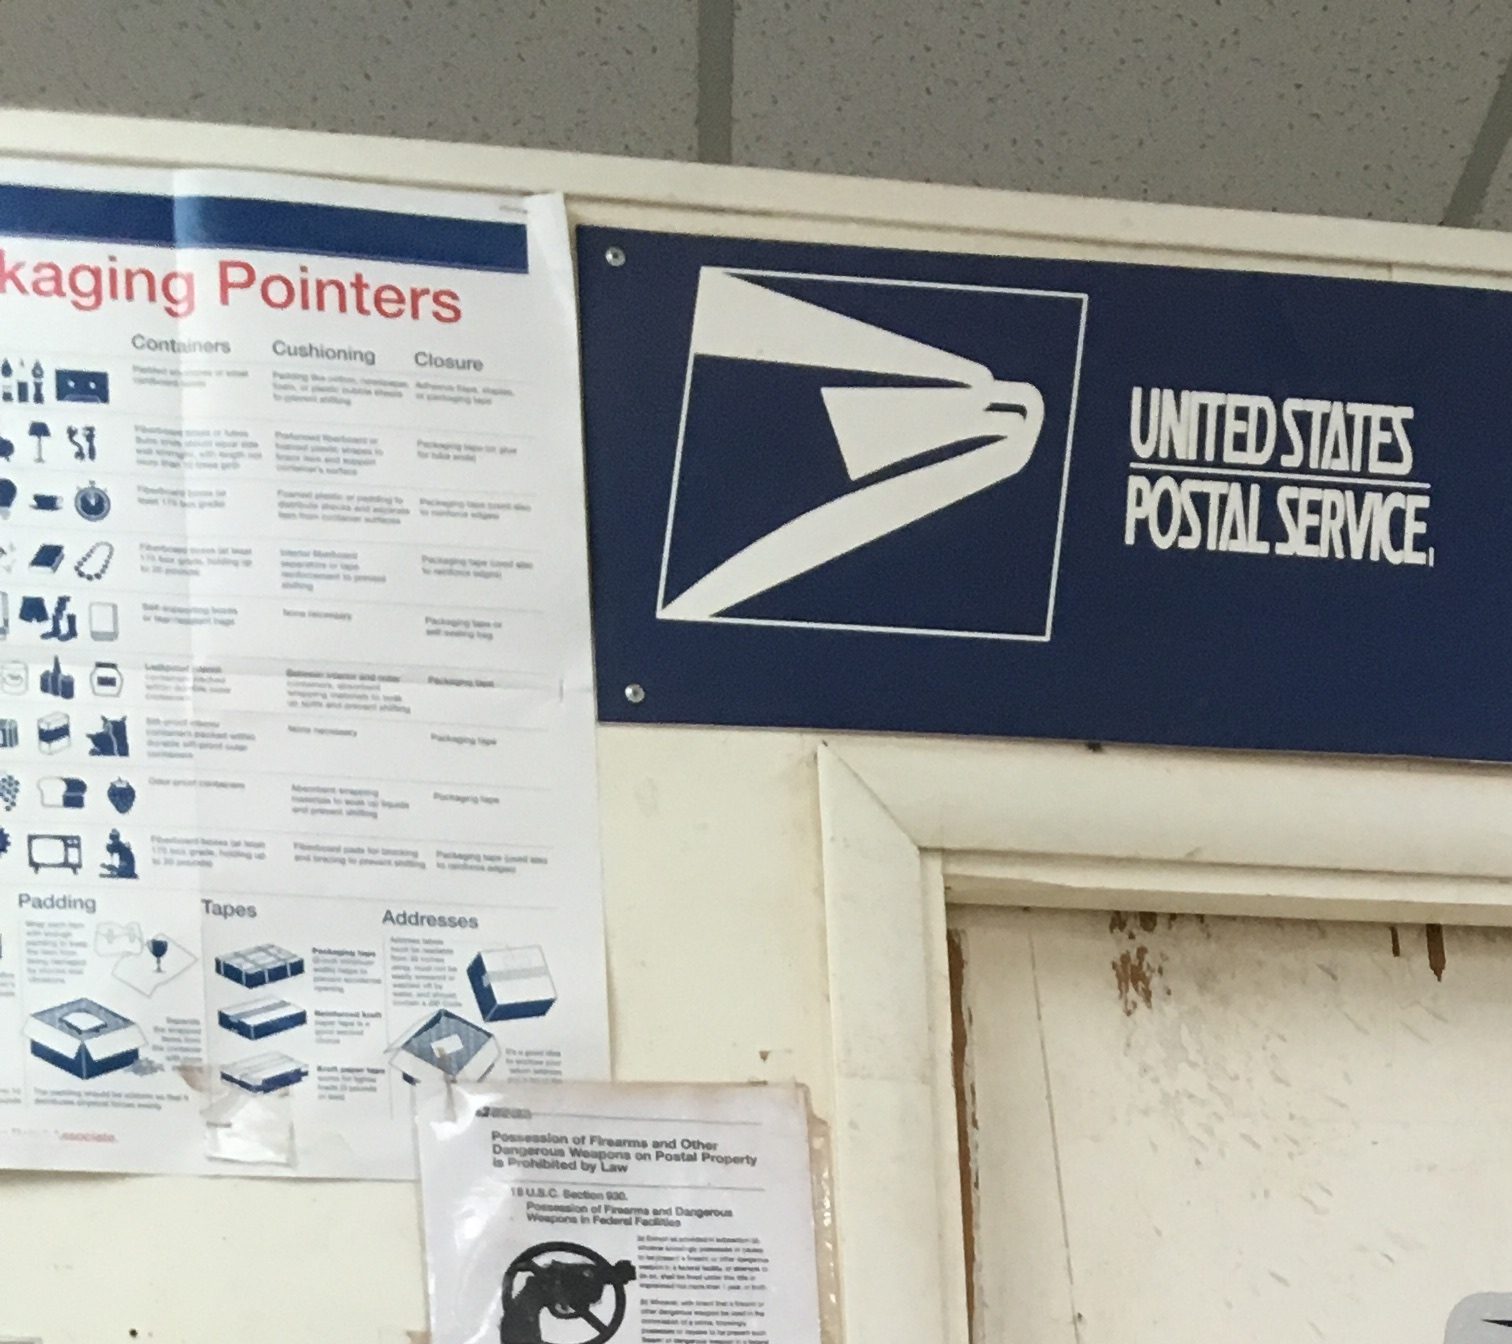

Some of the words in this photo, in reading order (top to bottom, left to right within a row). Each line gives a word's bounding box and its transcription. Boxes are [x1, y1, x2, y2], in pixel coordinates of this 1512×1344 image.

[218, 258, 463, 324] Pointers
[131, 333, 232, 355] Containers
[272, 339, 376, 366] Cushioning
[414, 351, 484, 373] Closure
[1130, 386, 1277, 465] UNITED
[1280, 398, 1414, 475] STATES
[1124, 474, 1270, 554] POSTAL
[18, 893, 97, 915] Padding
[201, 899, 258, 920] Tapes
[382, 909, 479, 931] Addresses
[491, 1131, 568, 1146] Possession
[572, 1135, 586, 1145] of
[590, 1136, 648, 1149] Firearms
[652, 1139, 677, 1150] and
[681, 1139, 718, 1151] Other
[492, 1144, 566, 1158] Dangerous
[569, 1147, 631, 1162] Weapons
[635, 1151, 651, 1162] on
[656, 1150, 698, 1163] Postal
[702, 1152, 757, 1167] Property
[508, 1158, 577, 1171] Prohibited
[581, 1161, 596, 1174] by
[600, 1162, 628, 1173] Law
